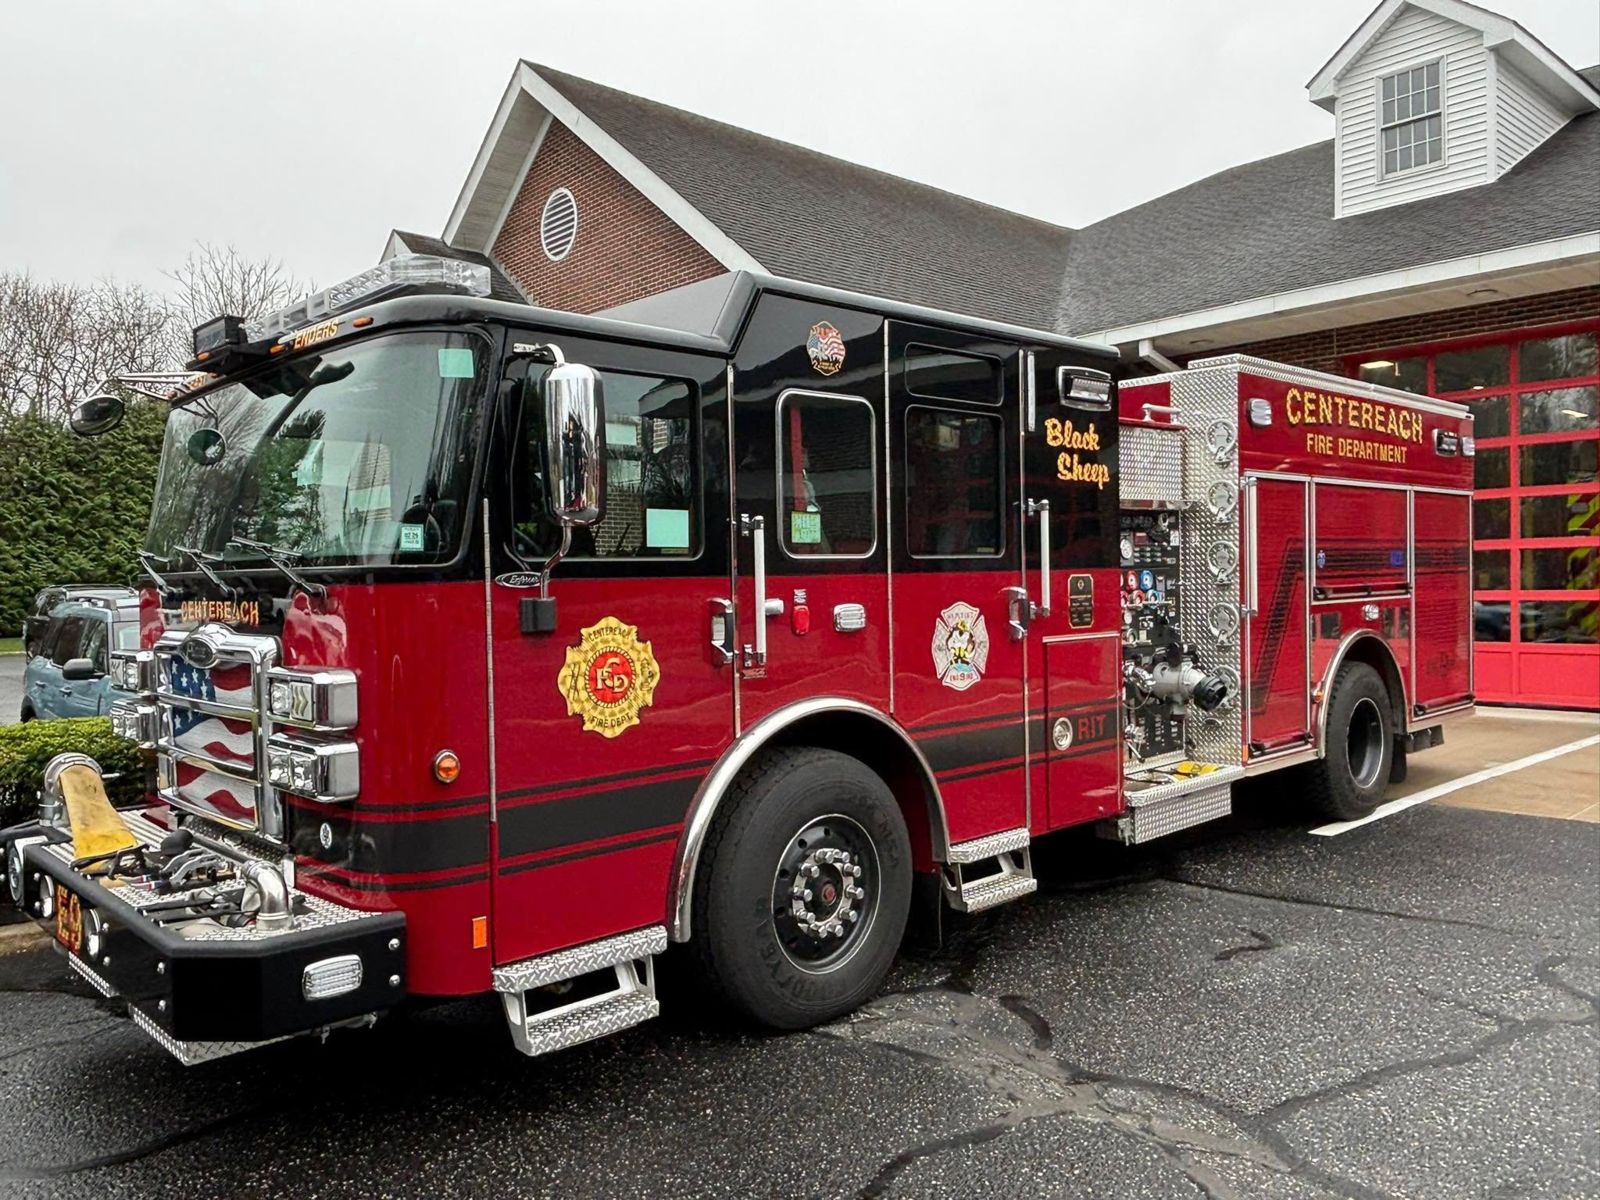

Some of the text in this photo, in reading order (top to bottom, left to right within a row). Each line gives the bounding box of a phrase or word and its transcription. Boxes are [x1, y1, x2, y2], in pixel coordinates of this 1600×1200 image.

[293, 320, 339, 349] ENDERS
[1286, 387, 1424, 444] CENTEREACH
[1044, 417, 1101, 451] Black
[1306, 432, 1408, 464] FIRE DEPARTMENT
[1057, 451, 1111, 490] Sheep
[180, 600, 260, 625] CENTEREACH
[590, 715, 609, 728] FIRE
[1077, 713, 1107, 741] RIT
